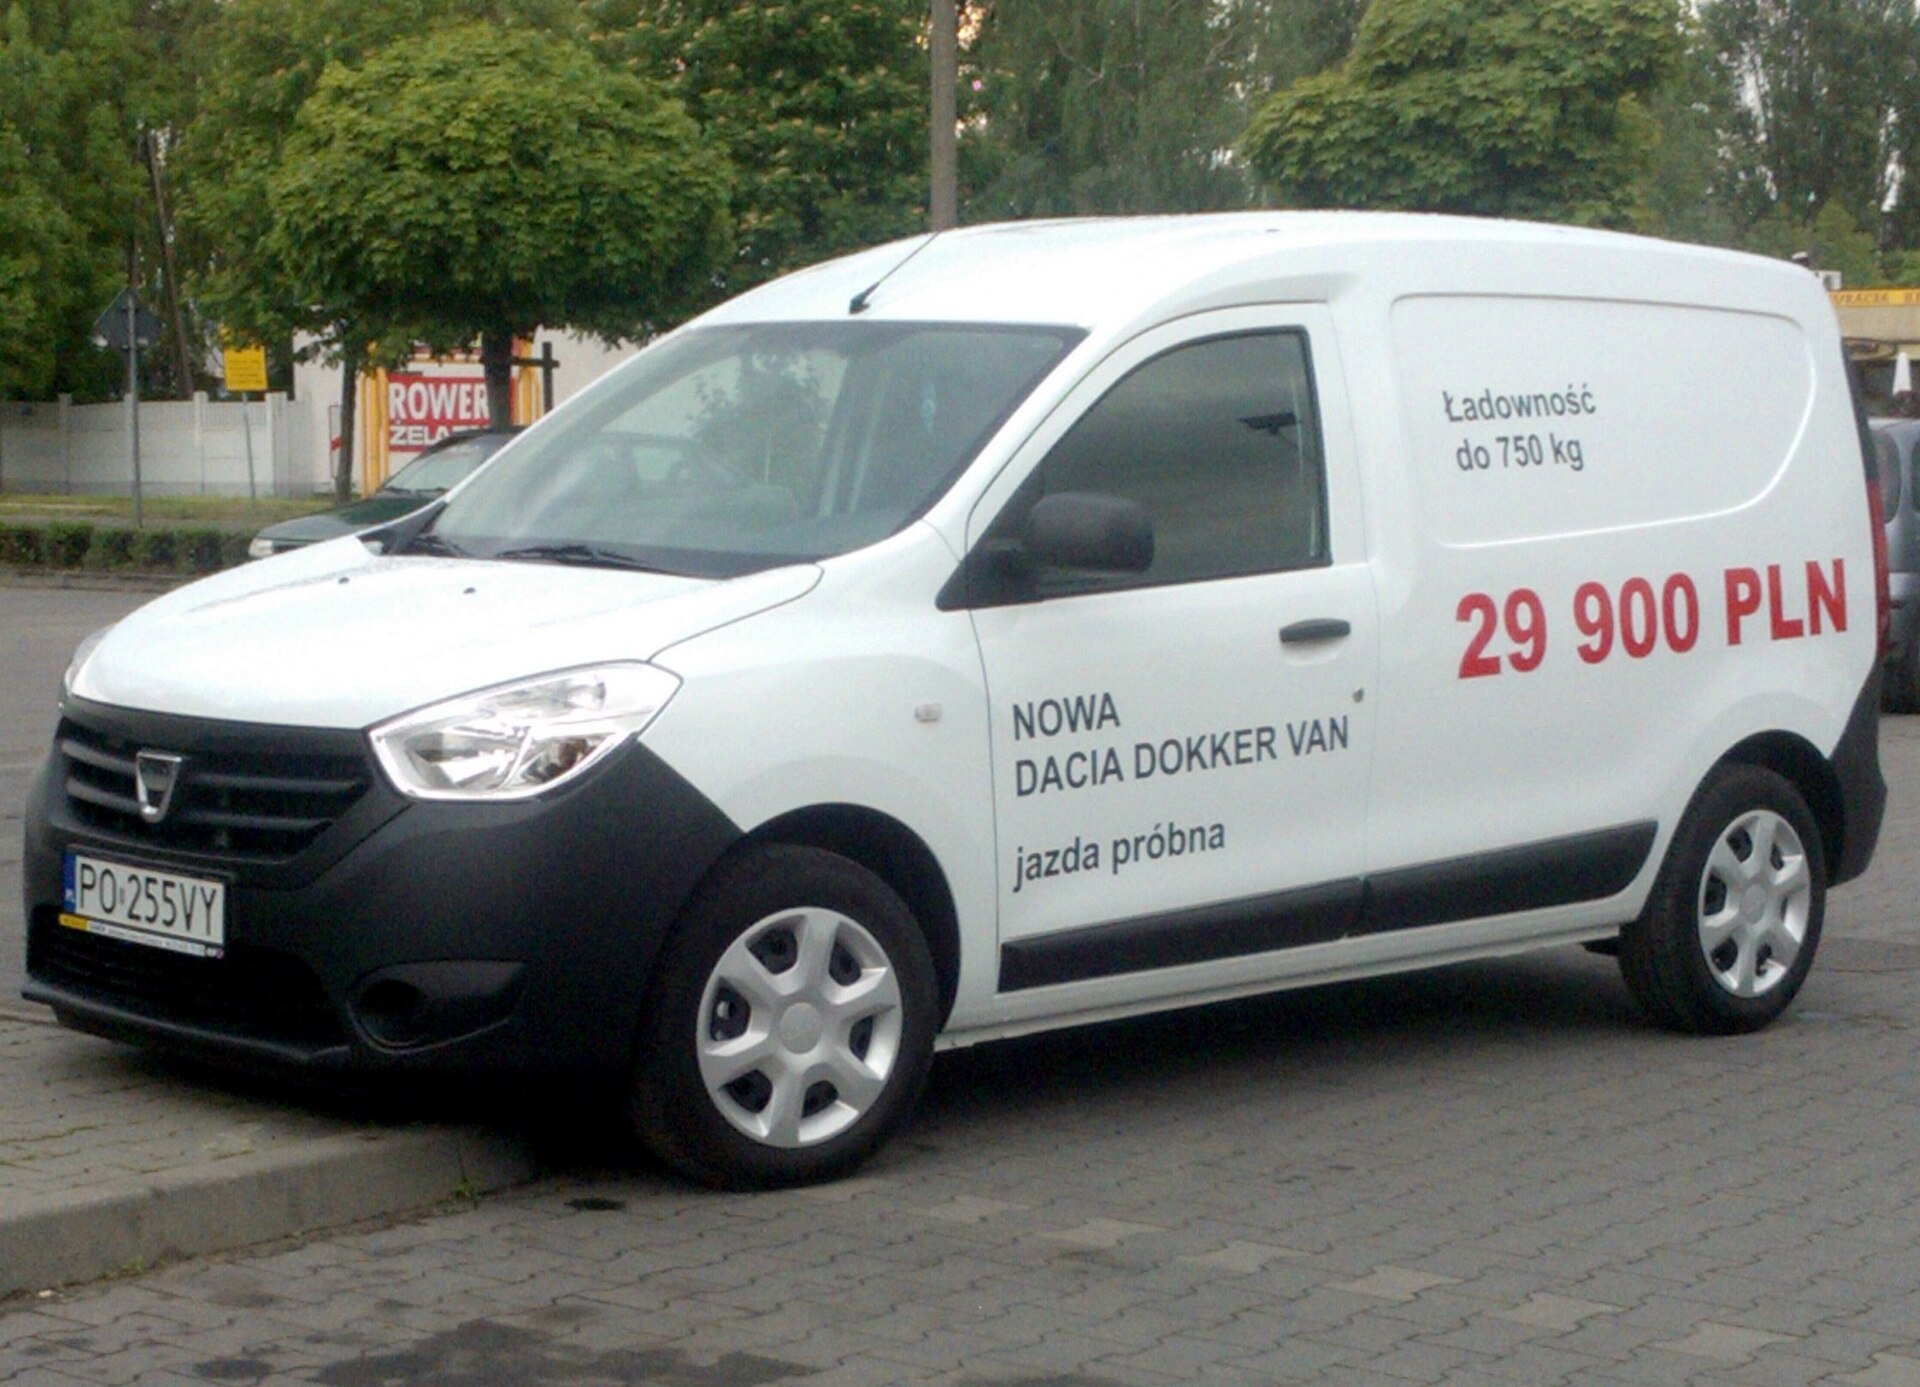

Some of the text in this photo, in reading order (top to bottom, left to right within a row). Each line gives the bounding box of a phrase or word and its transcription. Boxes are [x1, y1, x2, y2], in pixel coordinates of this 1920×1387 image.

[1443, 383, 1596, 422] Ładowność
[1456, 431, 1583, 471] do 750 kg
[1455, 558, 1847, 679] 29 900 PLN
[1013, 692, 1120, 740] NOWA
[1016, 715, 1349, 797] DACIA DOKKER VAN
[1013, 822, 1225, 893] jazda próbna
